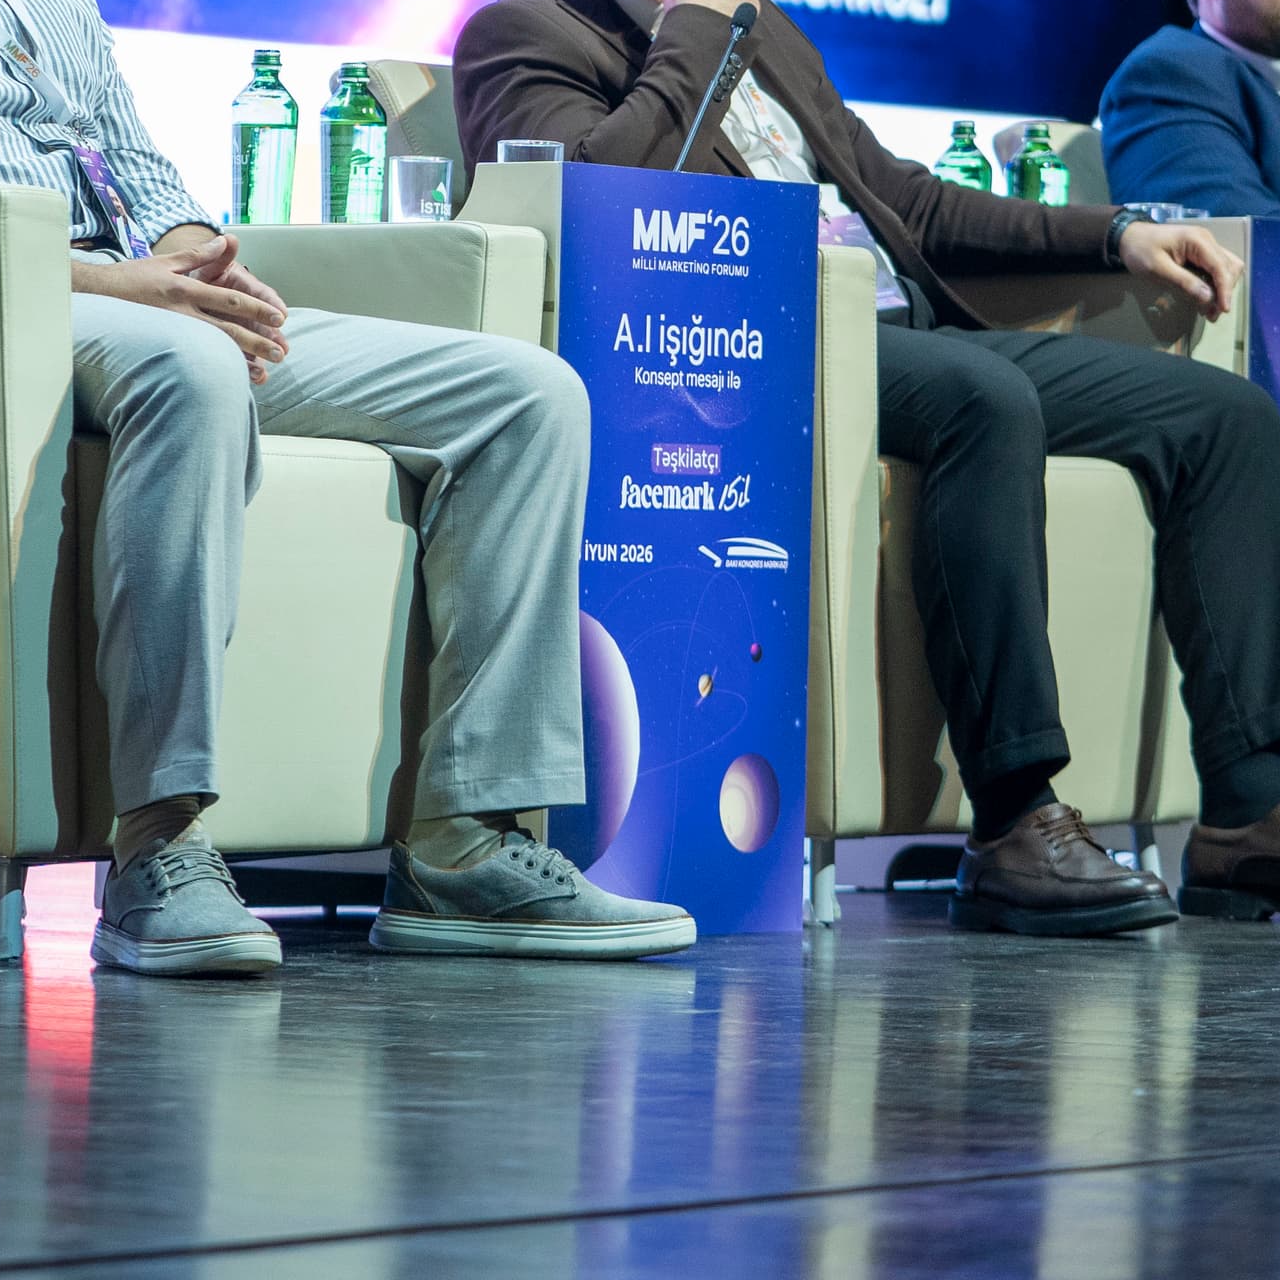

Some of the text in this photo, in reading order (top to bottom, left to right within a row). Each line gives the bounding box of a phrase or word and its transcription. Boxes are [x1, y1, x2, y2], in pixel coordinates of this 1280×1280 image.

[632, 256, 749, 277] MİLLİ MARKETİNQ FORUMU
[613, 313, 763, 366] A.I işığında
[635, 367, 741, 392] Konsept mesajı ilə
[653, 447, 718, 474] Təşkilatçı
[620, 475, 715, 510] facemark
[585, 539, 653, 563] İYUN 2026
